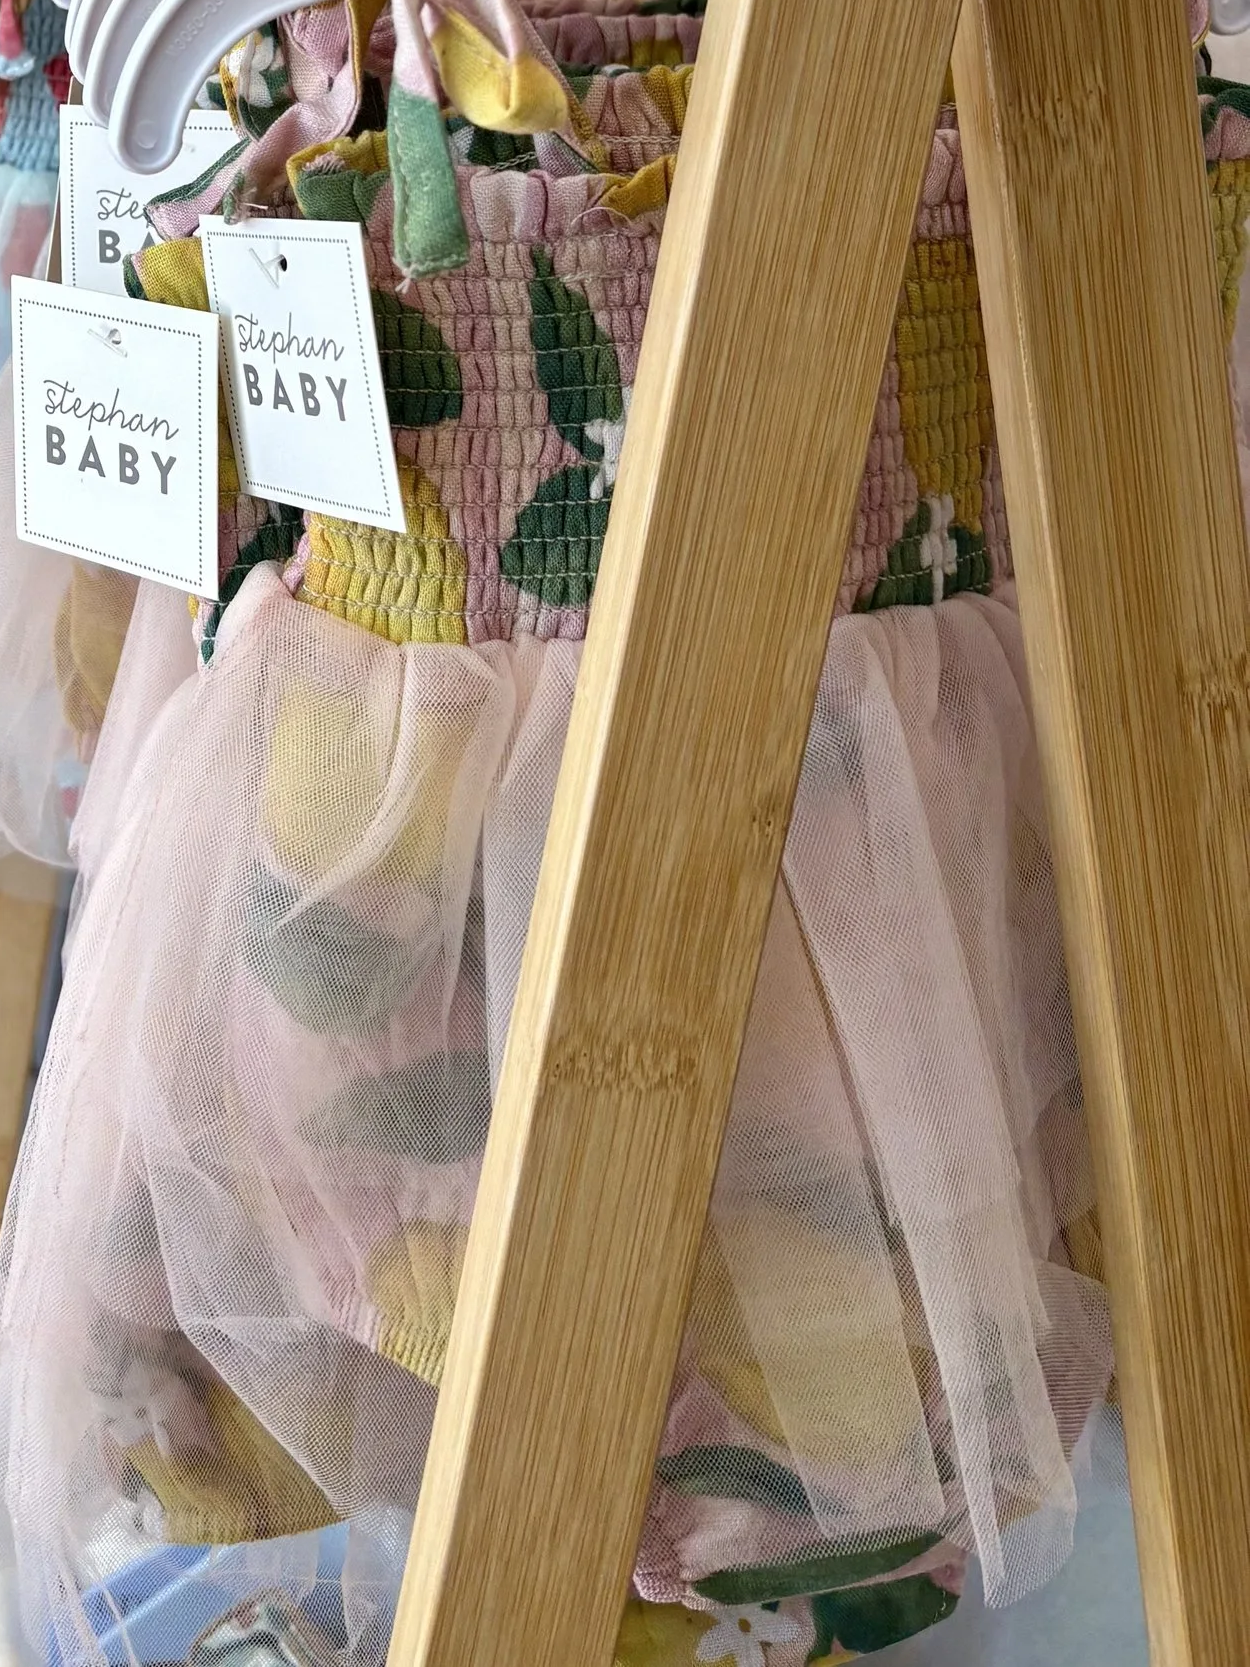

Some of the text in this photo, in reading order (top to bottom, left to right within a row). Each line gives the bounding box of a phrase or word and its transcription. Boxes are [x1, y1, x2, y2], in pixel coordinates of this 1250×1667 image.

[234, 312, 344, 364] stephan
[43, 379, 179, 440] stephan
[243, 363, 347, 422] BABY
[46, 424, 177, 495] BABY
